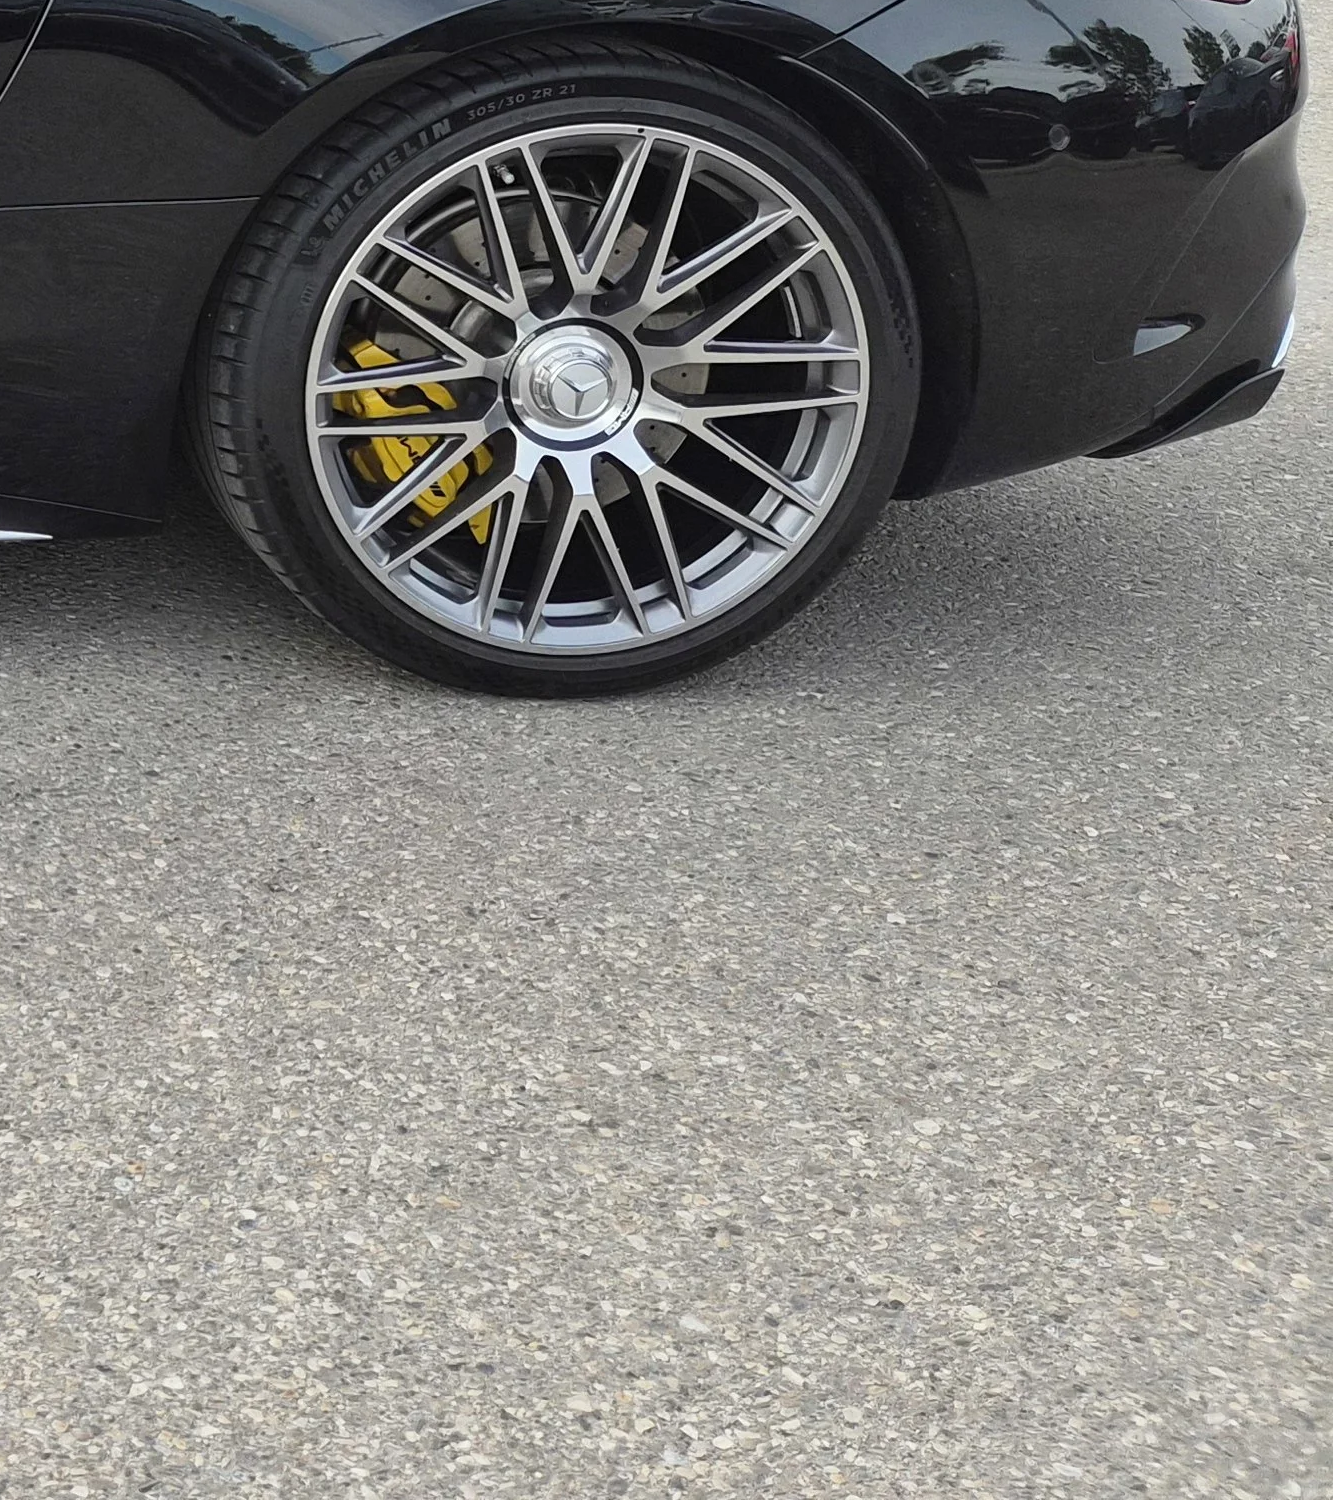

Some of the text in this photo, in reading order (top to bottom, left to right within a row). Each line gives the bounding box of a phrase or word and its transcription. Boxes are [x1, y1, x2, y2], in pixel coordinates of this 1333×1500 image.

[323, 83, 577, 232] MICHELIN 305/30 ZR 21
